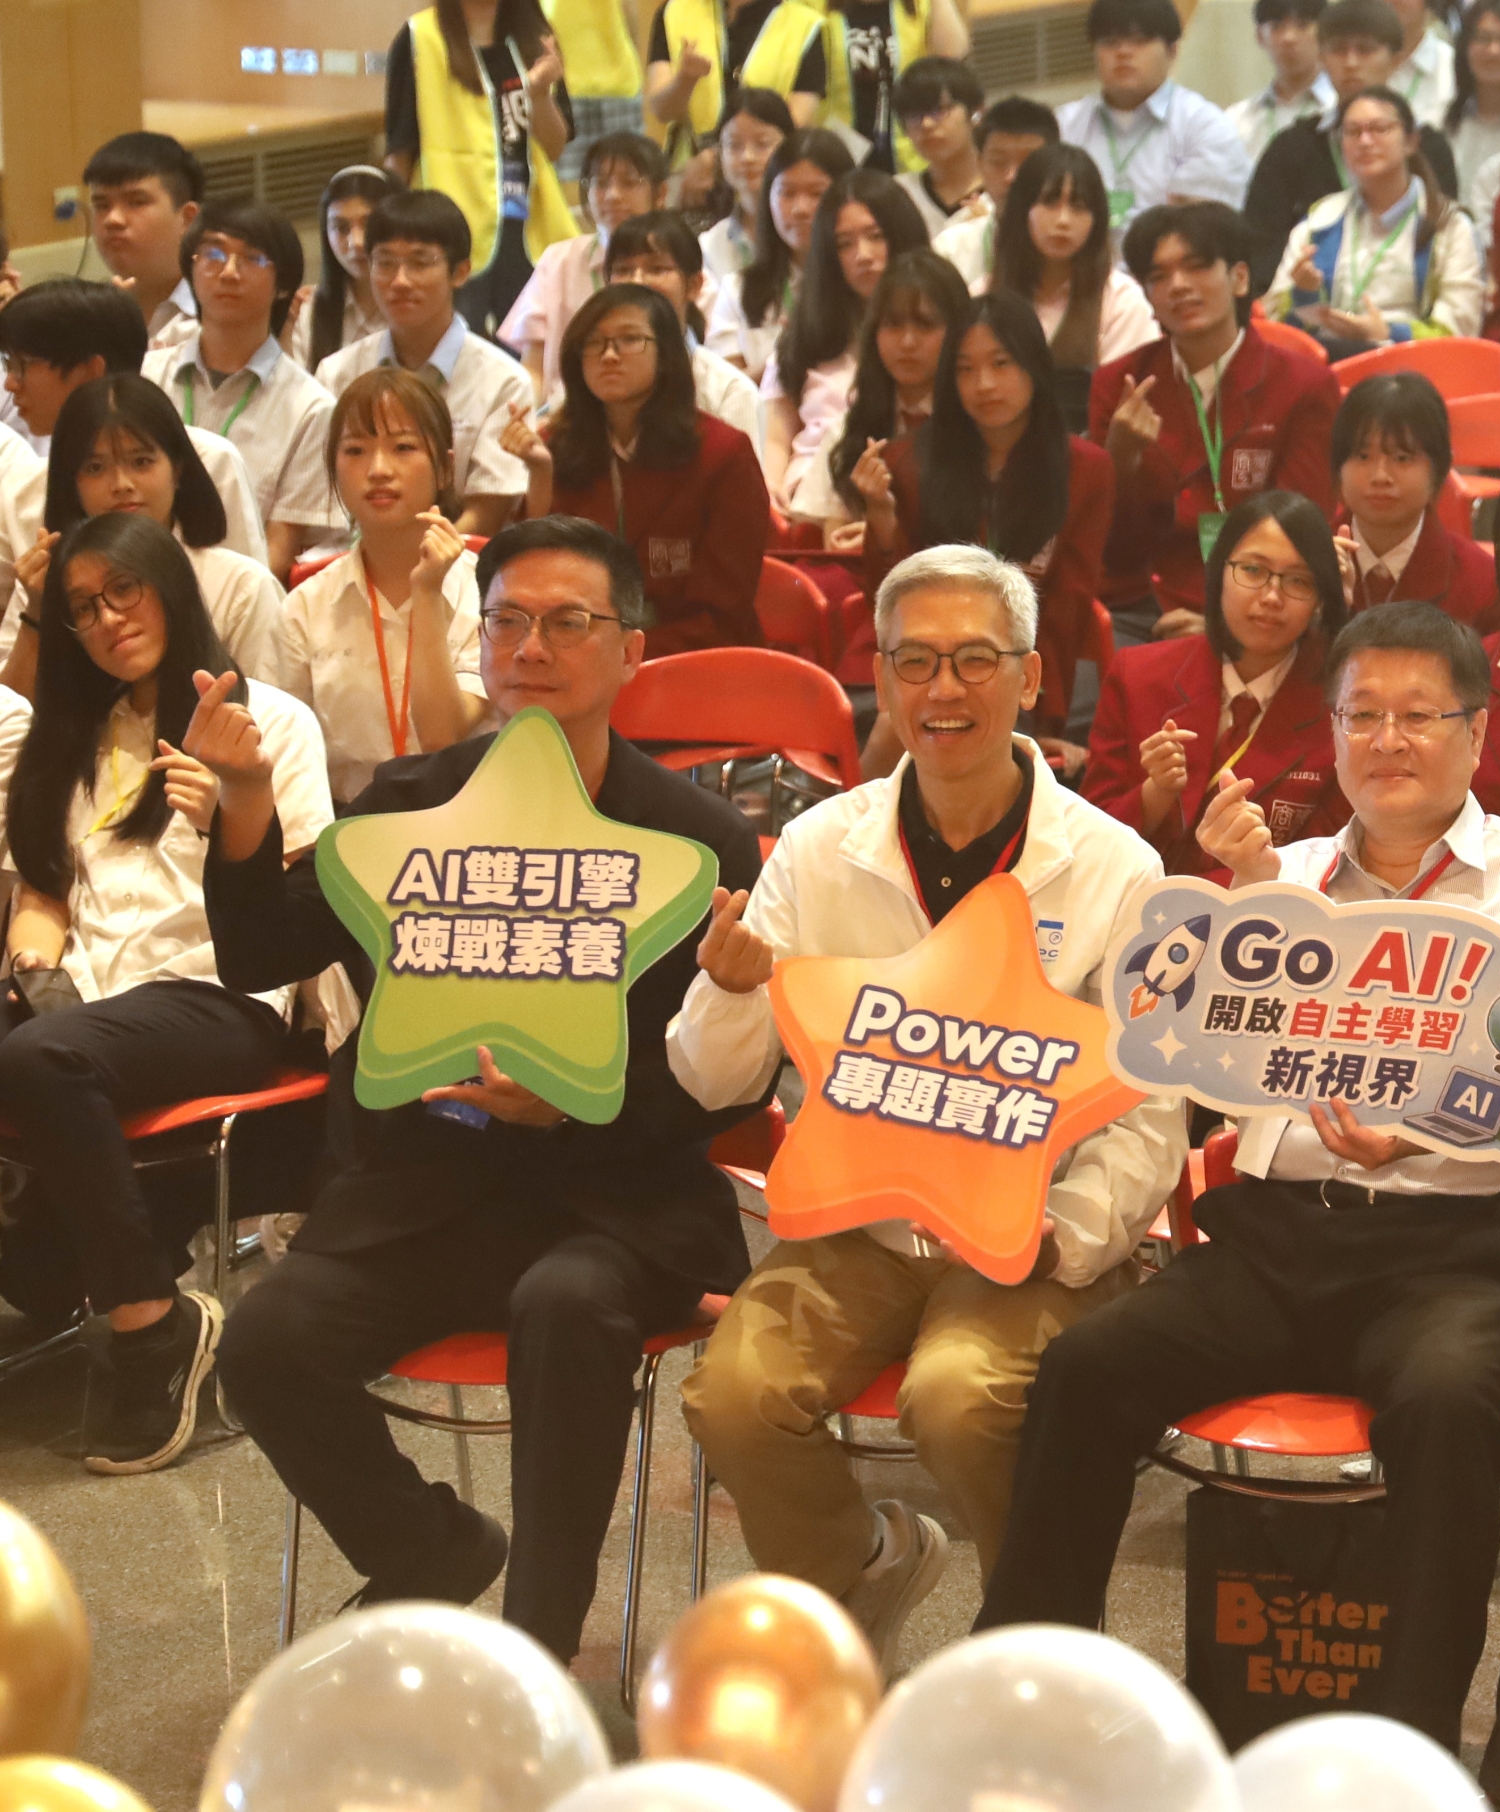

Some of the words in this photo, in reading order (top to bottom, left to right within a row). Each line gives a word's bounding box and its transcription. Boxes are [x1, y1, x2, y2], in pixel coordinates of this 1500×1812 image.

[390, 848, 637, 911] AI雙引擎
[390, 914, 623, 978] 煉戰素養
[1220, 918, 1334, 987] Go
[1347, 930, 1488, 1001] AI!
[848, 988, 1076, 1081] Power
[1203, 993, 1461, 1051] 開啟自主學習
[826, 1054, 1054, 1145] 專題實作
[1261, 1045, 1418, 1105] 新視界
[1453, 1084, 1494, 1118] AI
[1216, 1581, 1389, 1645] Better
[1247, 1654, 1359, 1700] Ever
[1275, 1628, 1382, 1669] Than
